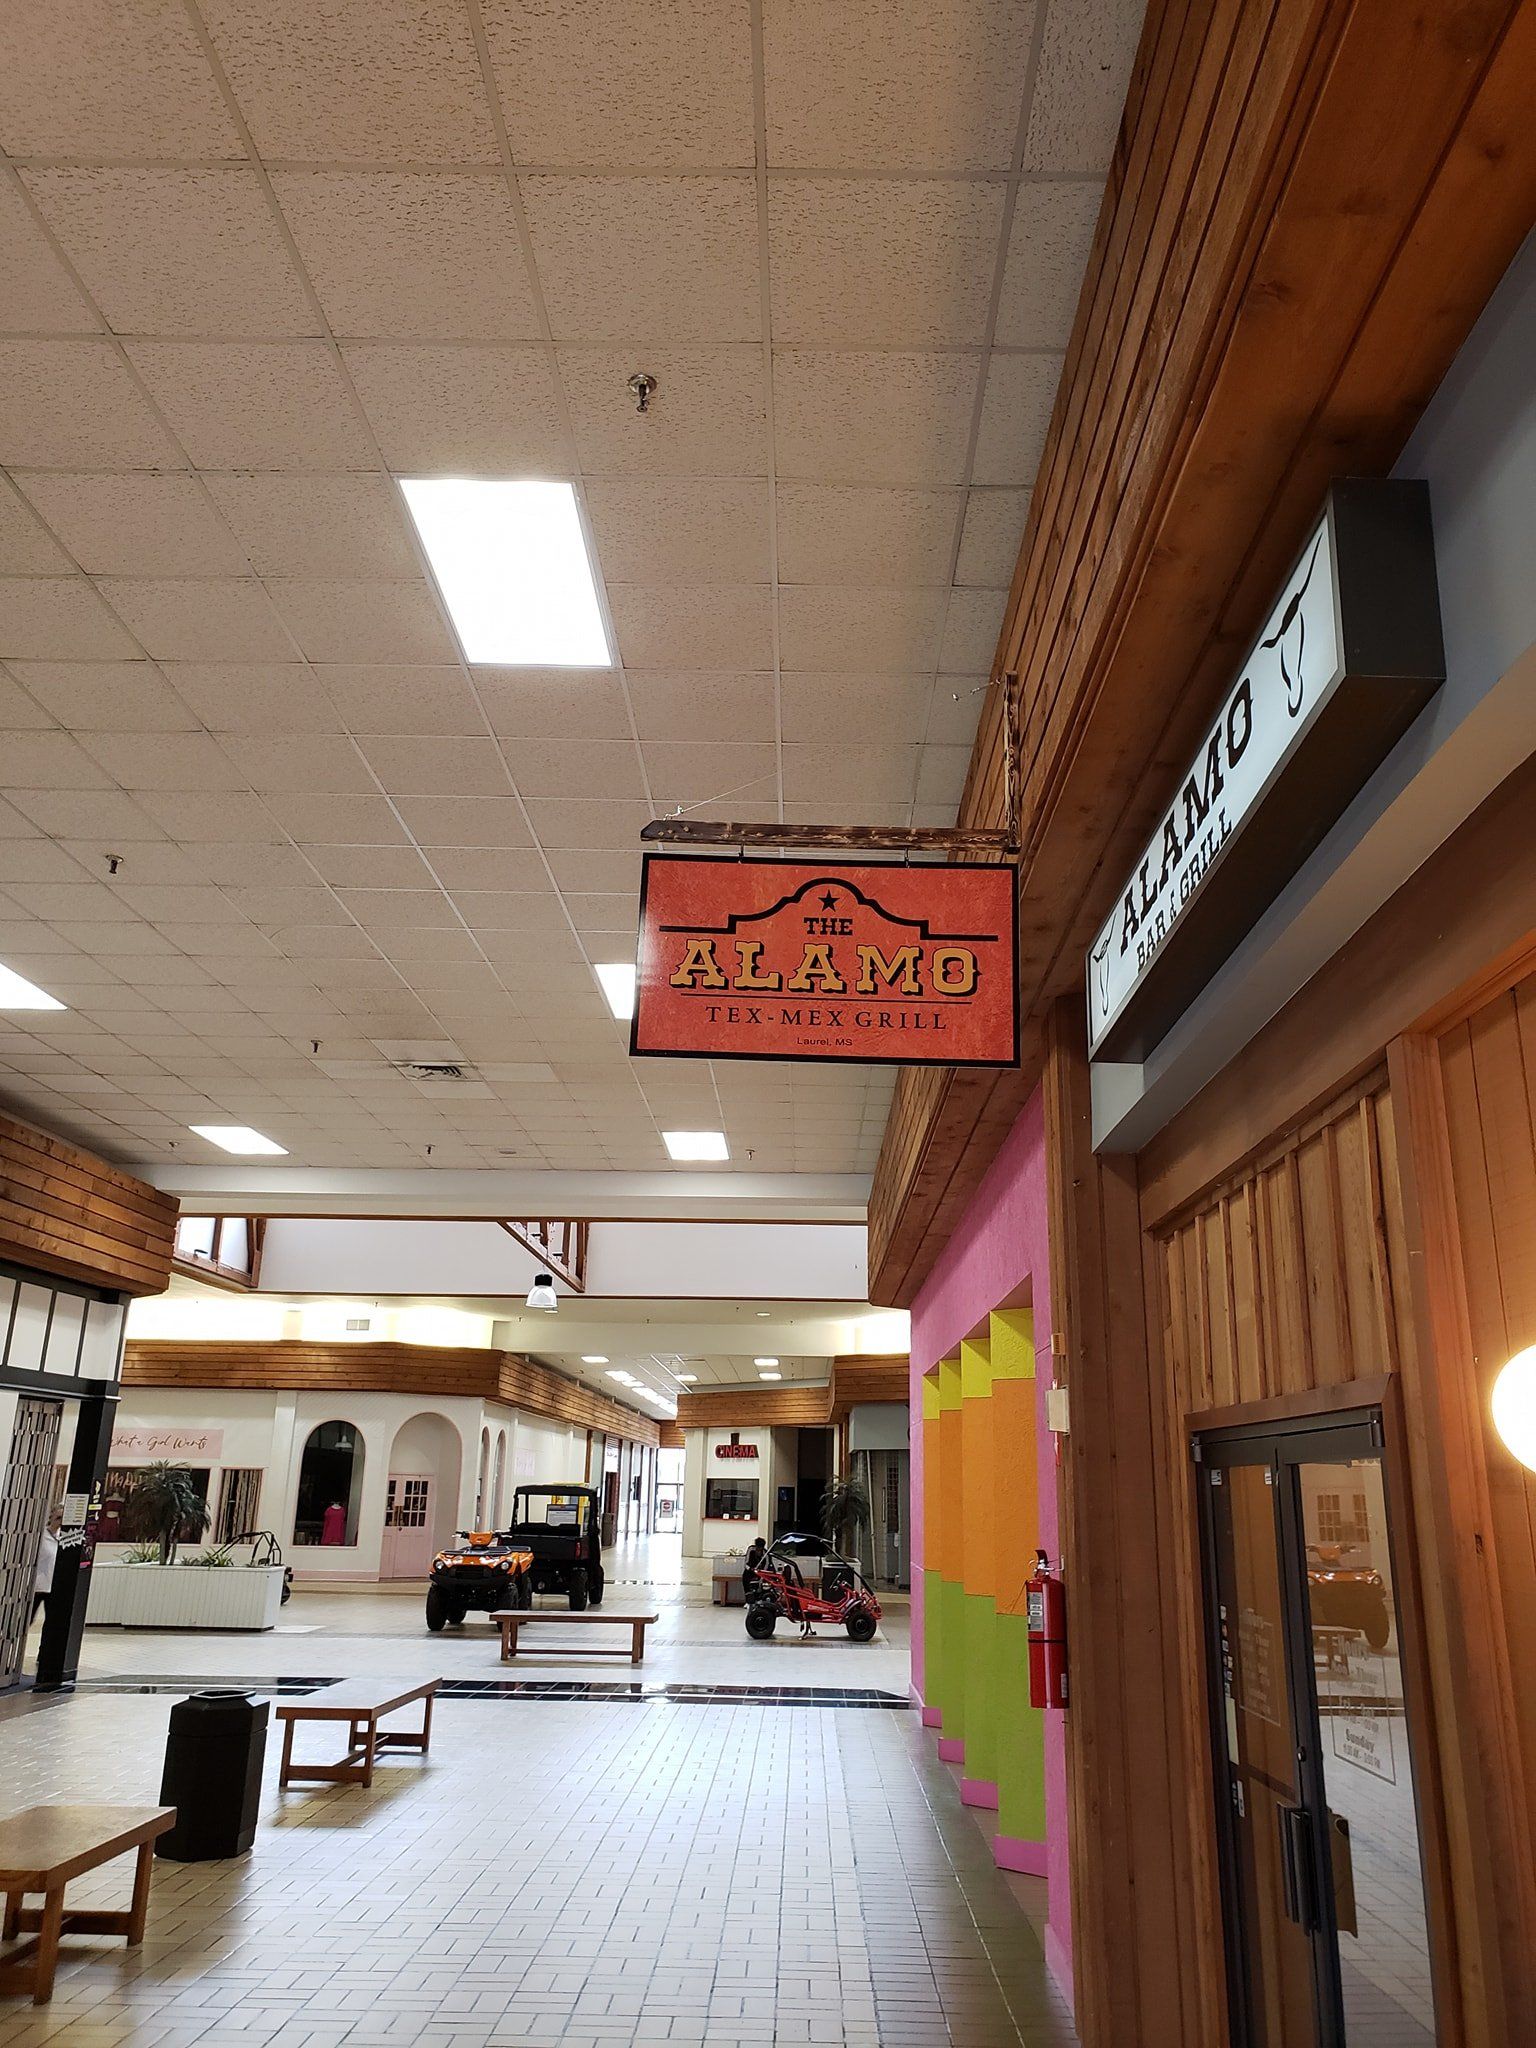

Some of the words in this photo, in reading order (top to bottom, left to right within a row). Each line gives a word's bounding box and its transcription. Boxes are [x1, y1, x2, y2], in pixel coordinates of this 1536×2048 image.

[1119, 677, 1255, 955] ALAMO
[1136, 914, 1169, 972] BAR
[1179, 807, 1233, 902] GRILL
[803, 917, 853, 936] THE
[669, 939, 982, 997] ALAMO
[705, 1005, 845, 1027] TEX-MEX
[854, 1010, 947, 1030] GRILL
[796, 1037, 832, 1047] Laurel,
[835, 1037, 853, 1046] MS
[716, 1445, 758, 1458] CINEMA
[1346, 1728, 1375, 1753] Sunday
